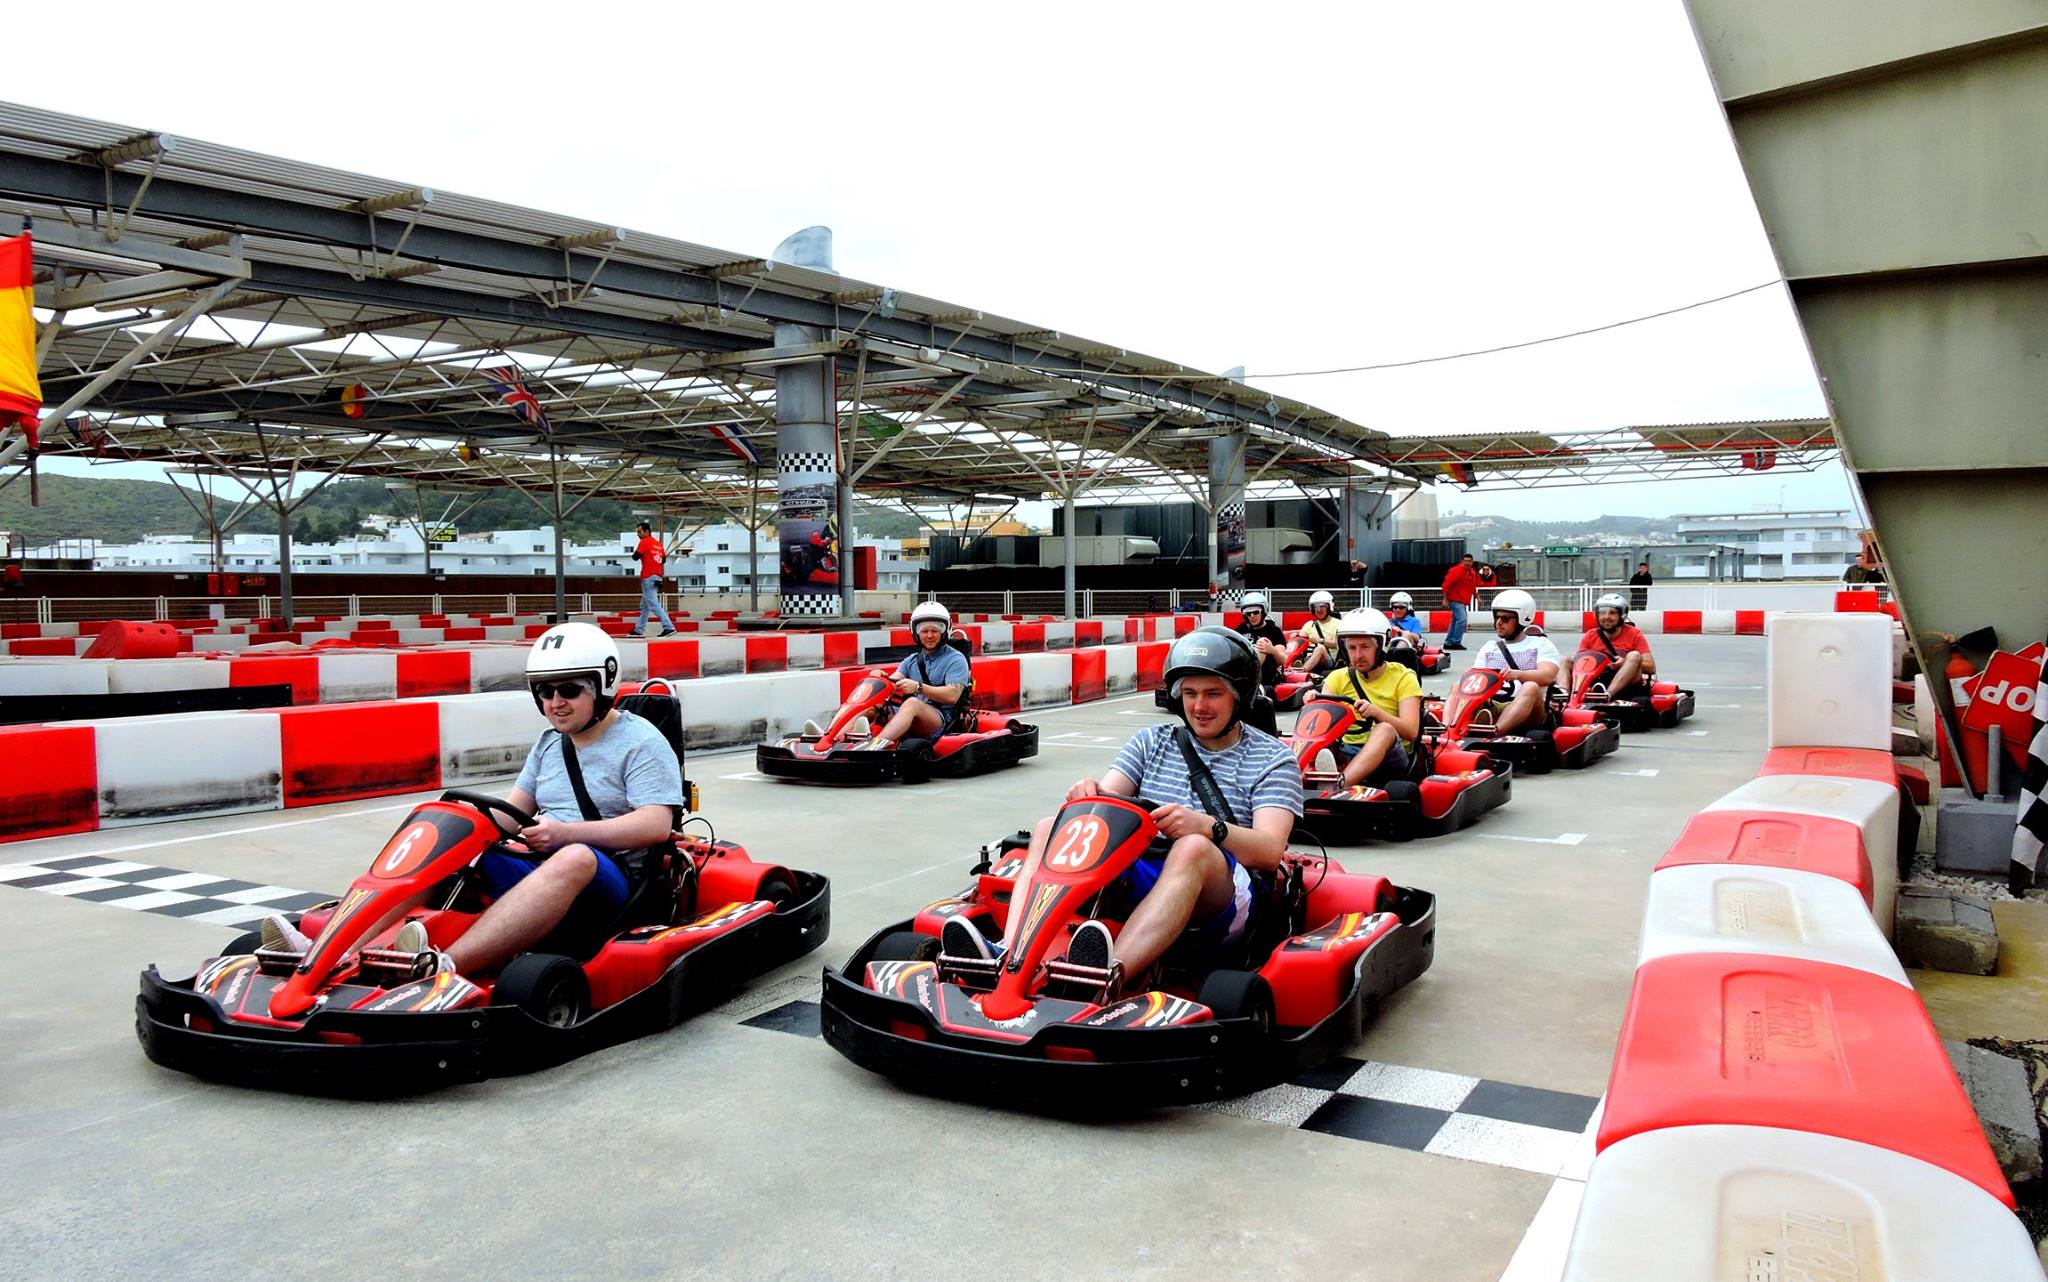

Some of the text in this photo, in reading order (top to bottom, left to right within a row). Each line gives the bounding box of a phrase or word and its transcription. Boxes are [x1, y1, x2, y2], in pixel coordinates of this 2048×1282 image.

[541, 634, 565, 651] M
[1461, 674, 1483, 692] 24
[1980, 680, 2036, 712] OP
[1306, 713, 1320, 735] 4
[385, 827, 424, 871] 6
[1051, 820, 1099, 867] 23
